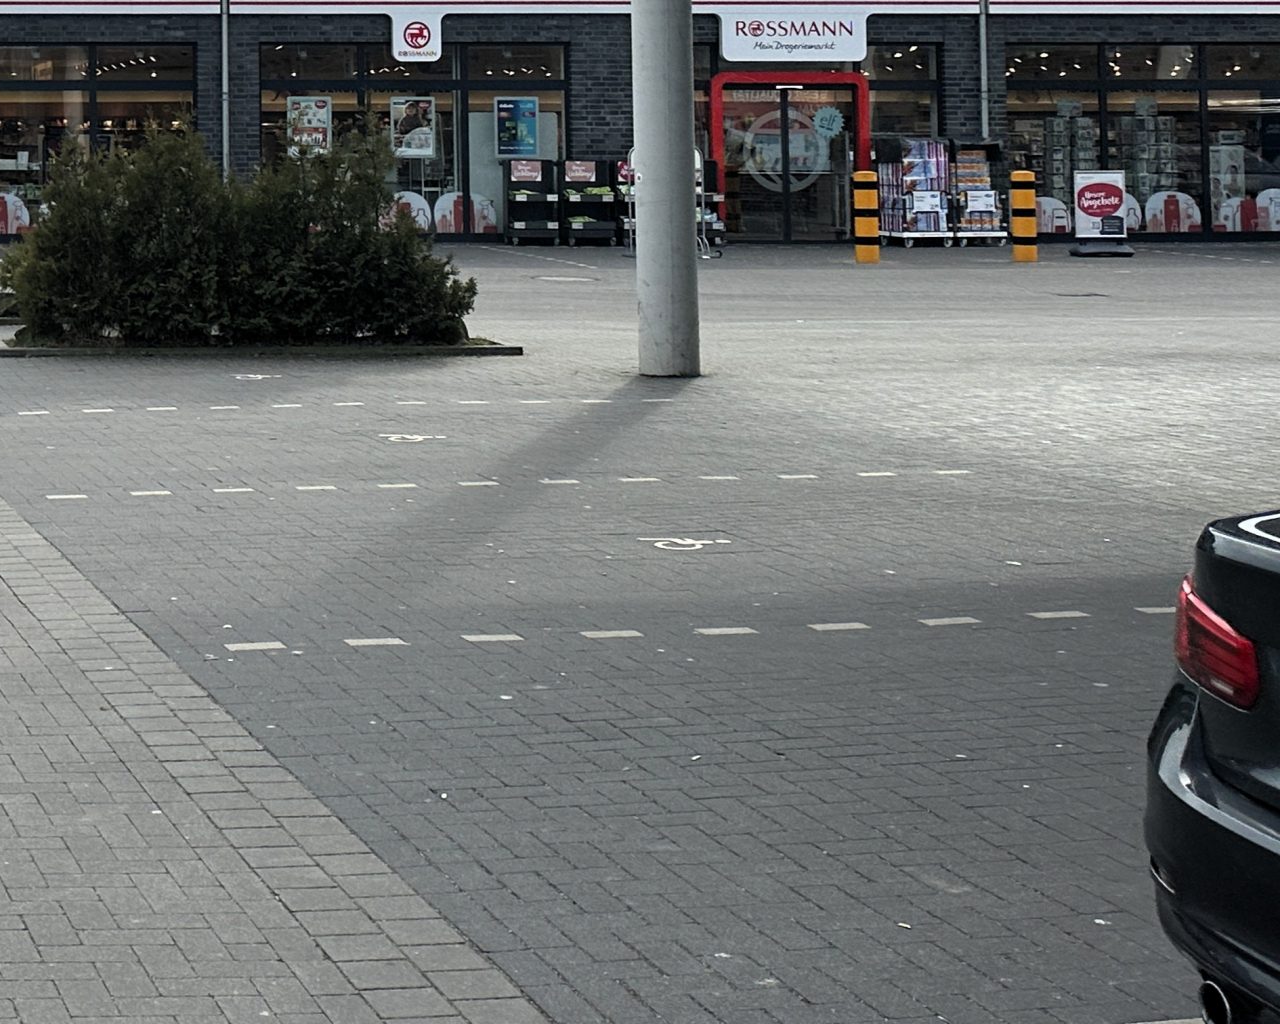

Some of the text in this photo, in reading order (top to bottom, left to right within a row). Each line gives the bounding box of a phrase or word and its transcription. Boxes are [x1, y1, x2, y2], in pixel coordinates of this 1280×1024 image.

[735, 20, 853, 37] ROSSMANN
[753, 41, 837, 53] Mein Drogeriemarkt
[1081, 196, 1120, 208] Angebote
